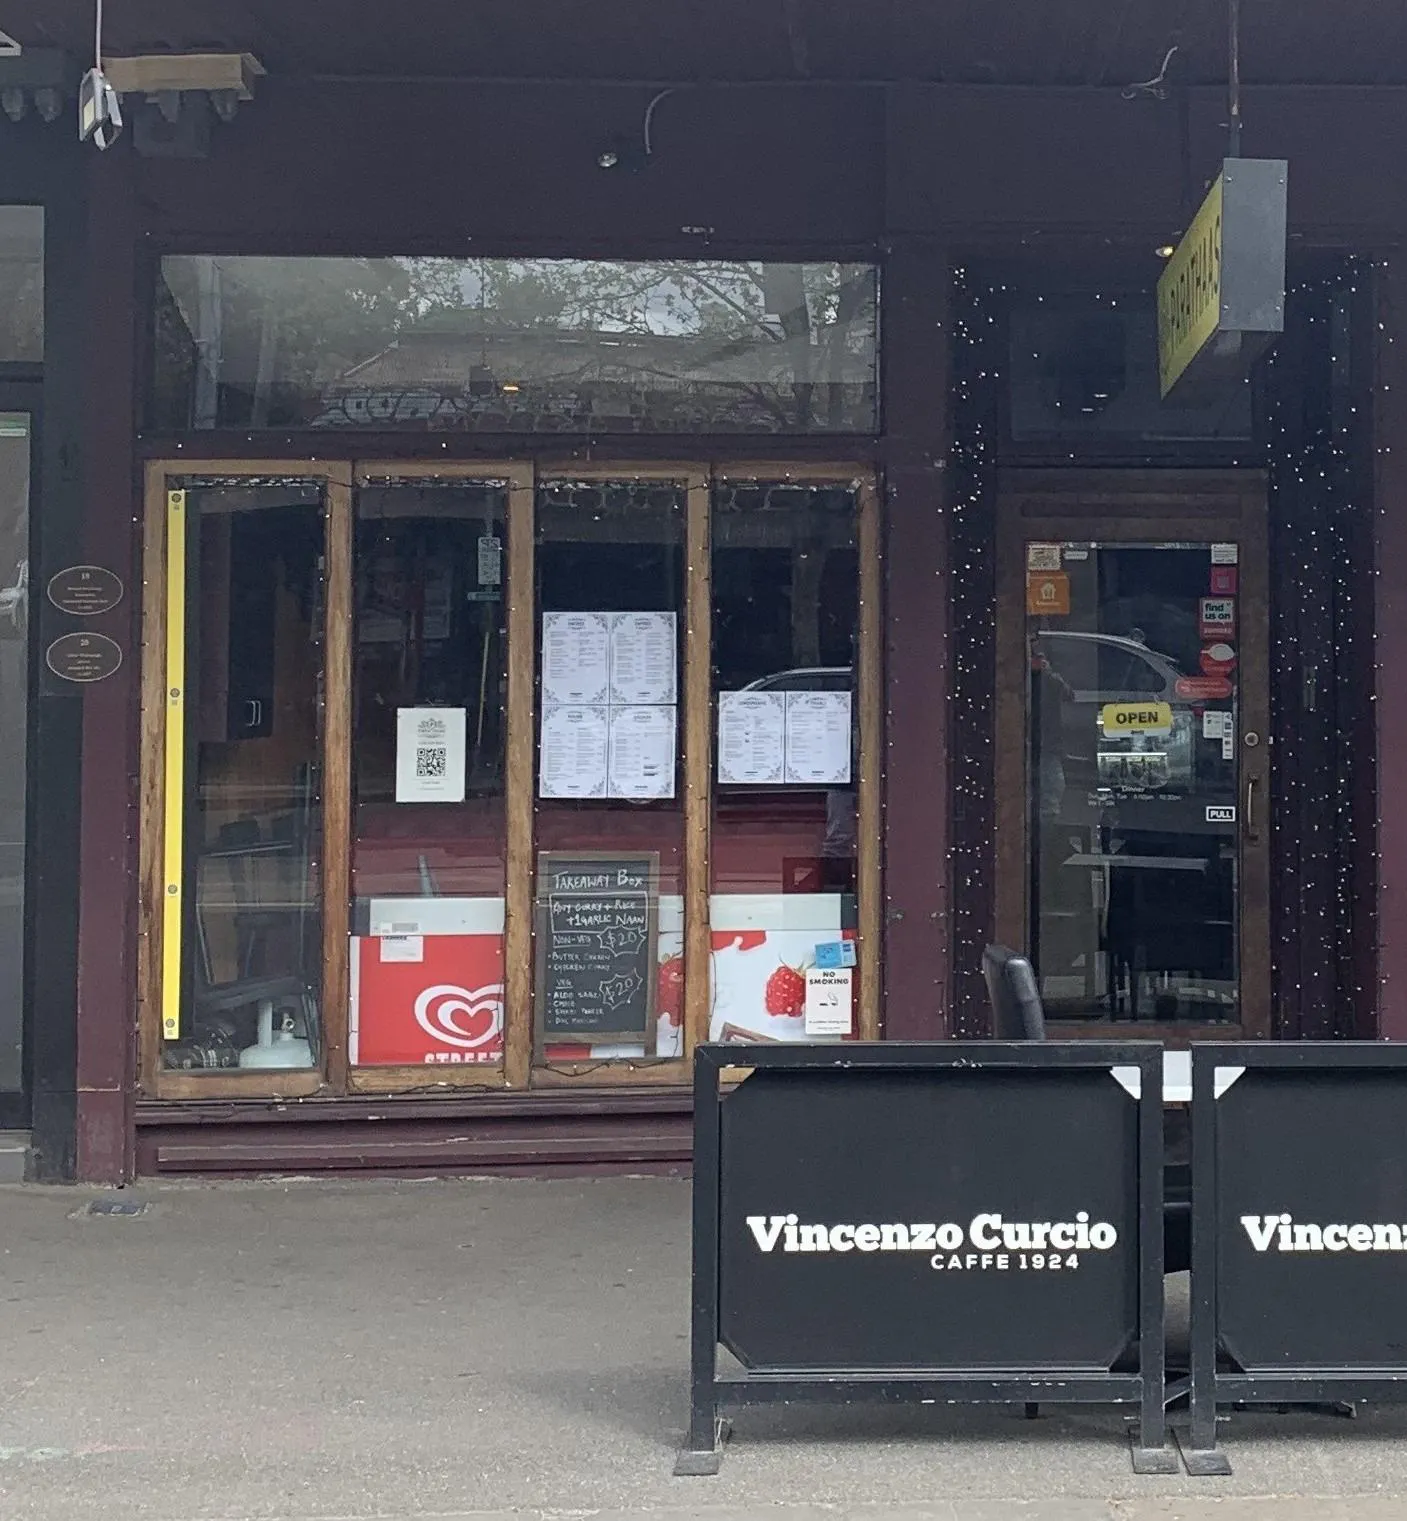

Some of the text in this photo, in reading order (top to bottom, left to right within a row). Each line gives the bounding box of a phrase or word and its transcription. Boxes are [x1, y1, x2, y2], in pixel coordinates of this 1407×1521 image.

[1205, 602, 1224, 611] find
[1116, 711, 1159, 724] OPEN
[1210, 810, 1231, 819] PULL
[552, 870, 610, 889] TAKEAWAY
[605, 930, 637, 948] $20
[605, 977, 634, 1003] $20
[746, 1211, 1118, 1252] Vincenzo Curcio
[931, 1254, 1079, 1270] CAFFE 1924
